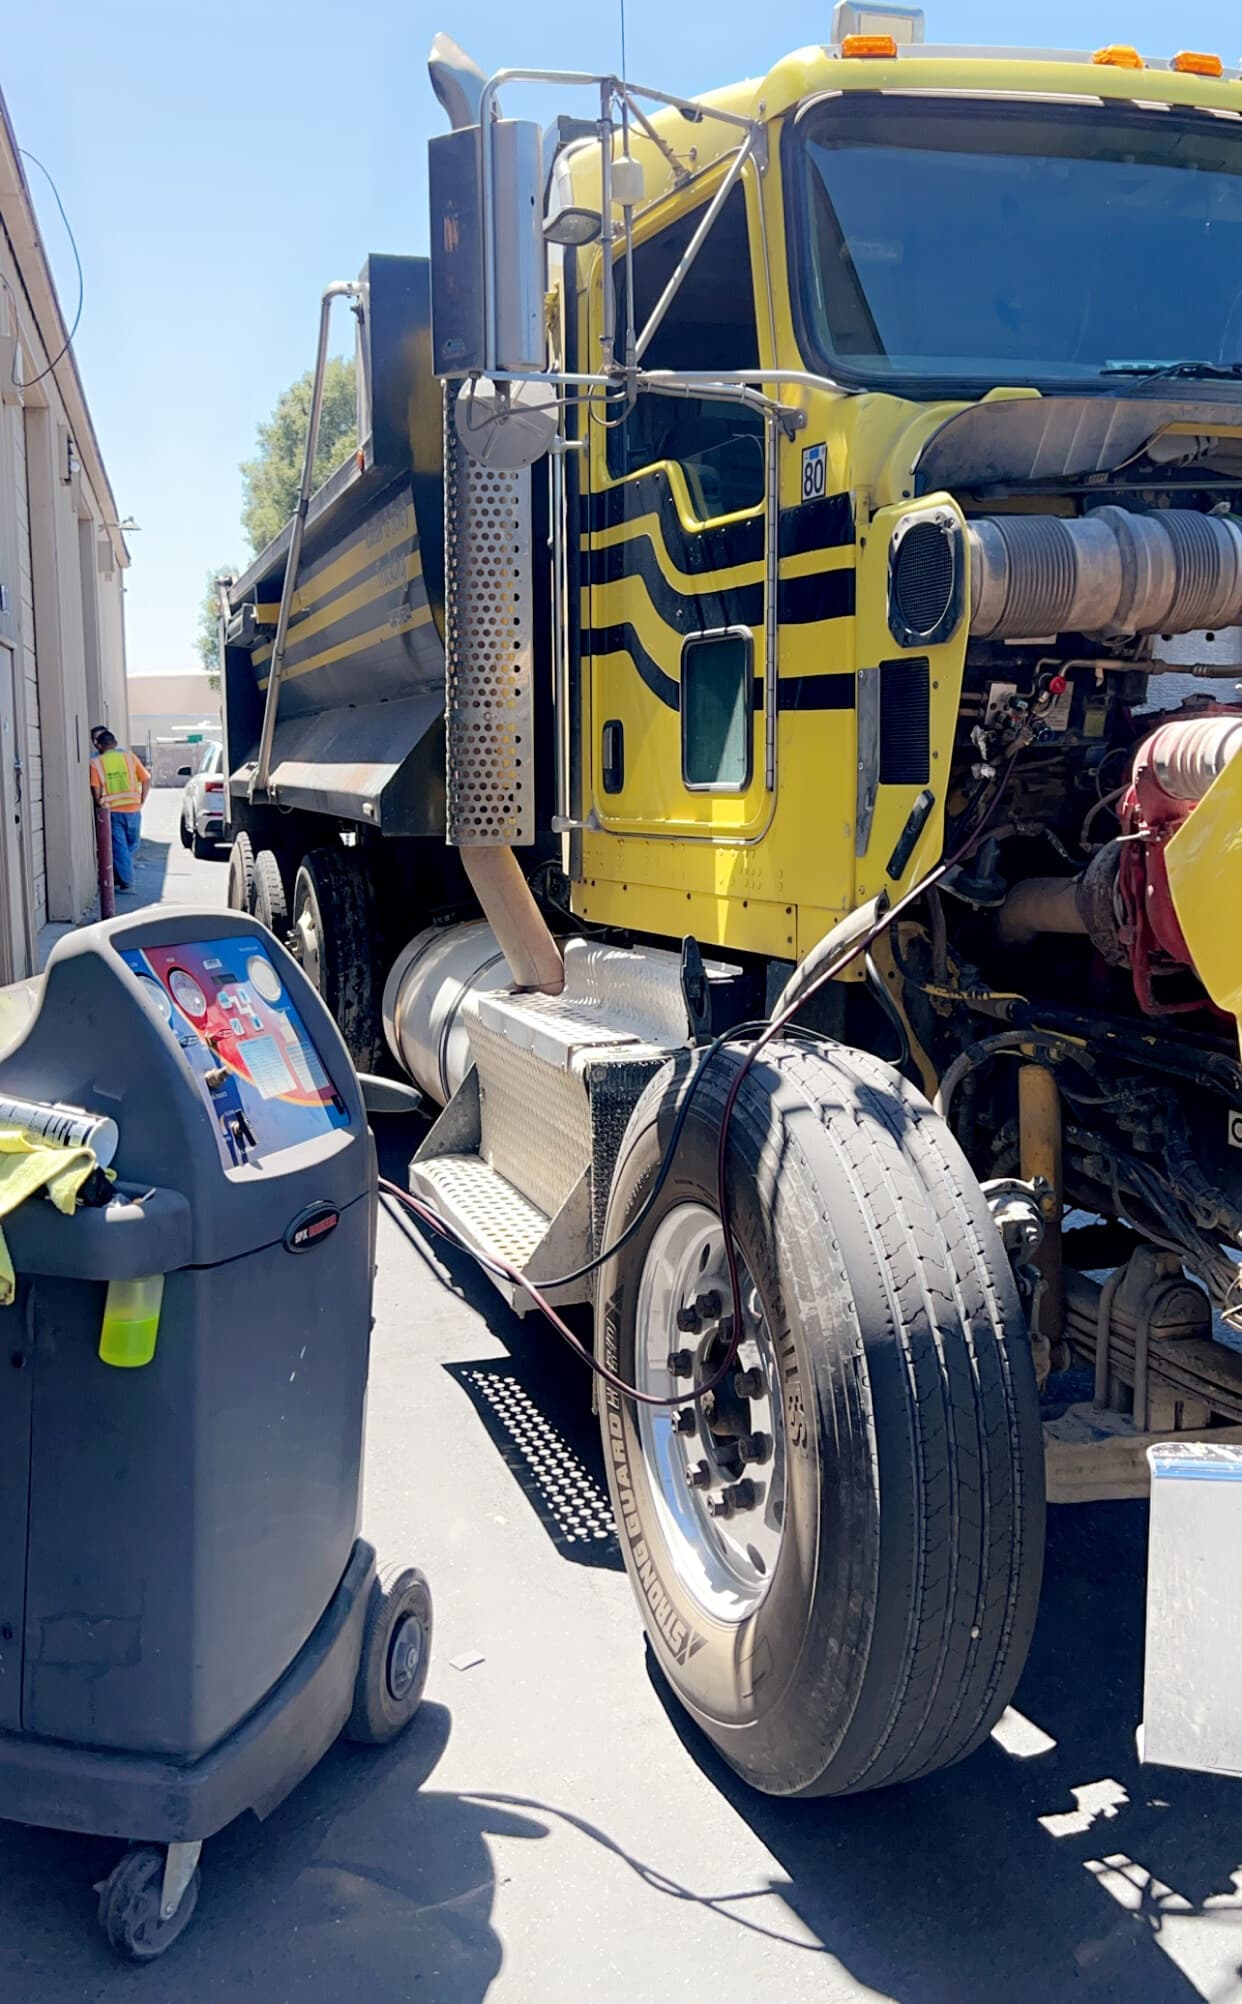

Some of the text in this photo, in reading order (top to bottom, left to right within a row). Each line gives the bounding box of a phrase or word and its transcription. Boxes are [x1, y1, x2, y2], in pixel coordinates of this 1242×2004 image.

[803, 459, 823, 497] 80
[608, 1412, 688, 1657] STRONG GUARD
